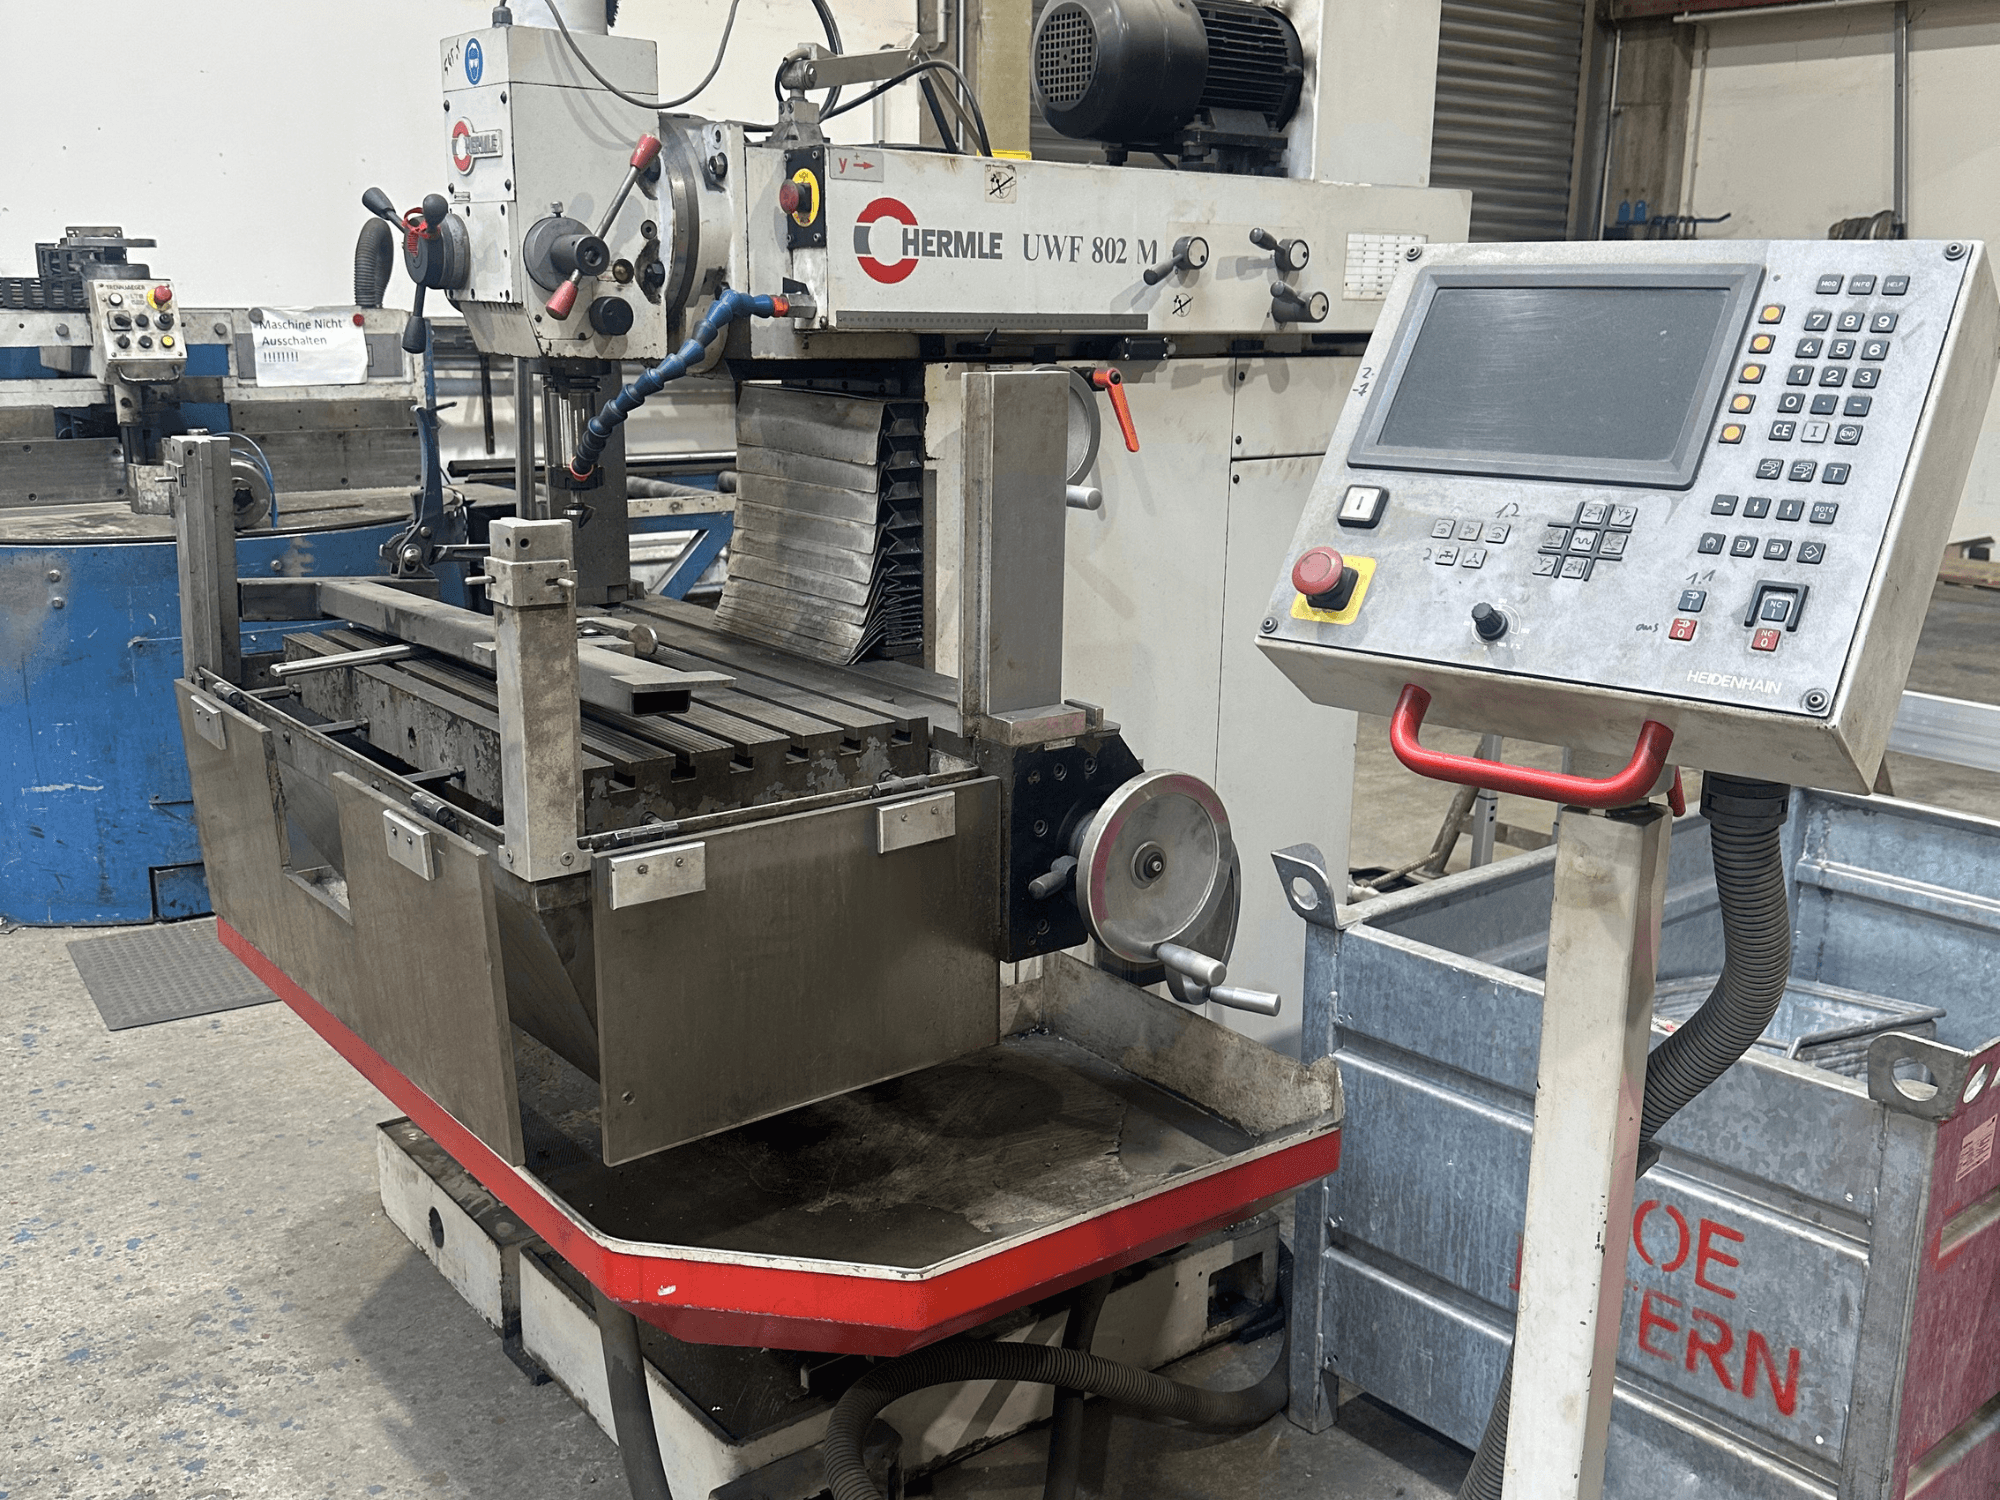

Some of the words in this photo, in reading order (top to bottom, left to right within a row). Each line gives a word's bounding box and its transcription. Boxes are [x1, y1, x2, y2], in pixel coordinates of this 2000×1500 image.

[464, 134, 498, 154] HERMLE
[902, 228, 1003, 260] HERMLE
[1022, 233, 1084, 264] UWF
[1091, 236, 1128, 265] 802
[1136, 239, 1158, 265] M
[259, 319, 312, 330] Maschine
[314, 318, 343, 329] Nicht
[1812, 314, 1825, 326] 7
[1844, 315, 1856, 327] 8
[1878, 316, 1891, 328] 9
[262, 335, 327, 347] Ausschalten
[1802, 342, 1814, 354] 4
[1835, 342, 1848, 355] 5
[1868, 343, 1881, 356] 6
[1796, 368, 1805, 381] 1
[1825, 370, 1839, 382] 2
[1859, 371, 1872, 383] 3
[1773, 424, 1792, 437] CE
[1814, 505, 1834, 513] GOTO
[1769, 600, 1783, 608] NC
[1761, 629, 1774, 637] NC
[1687, 669, 1782, 694] HEIDENHAIN
[1626, 1279, 1800, 1417] ERN
